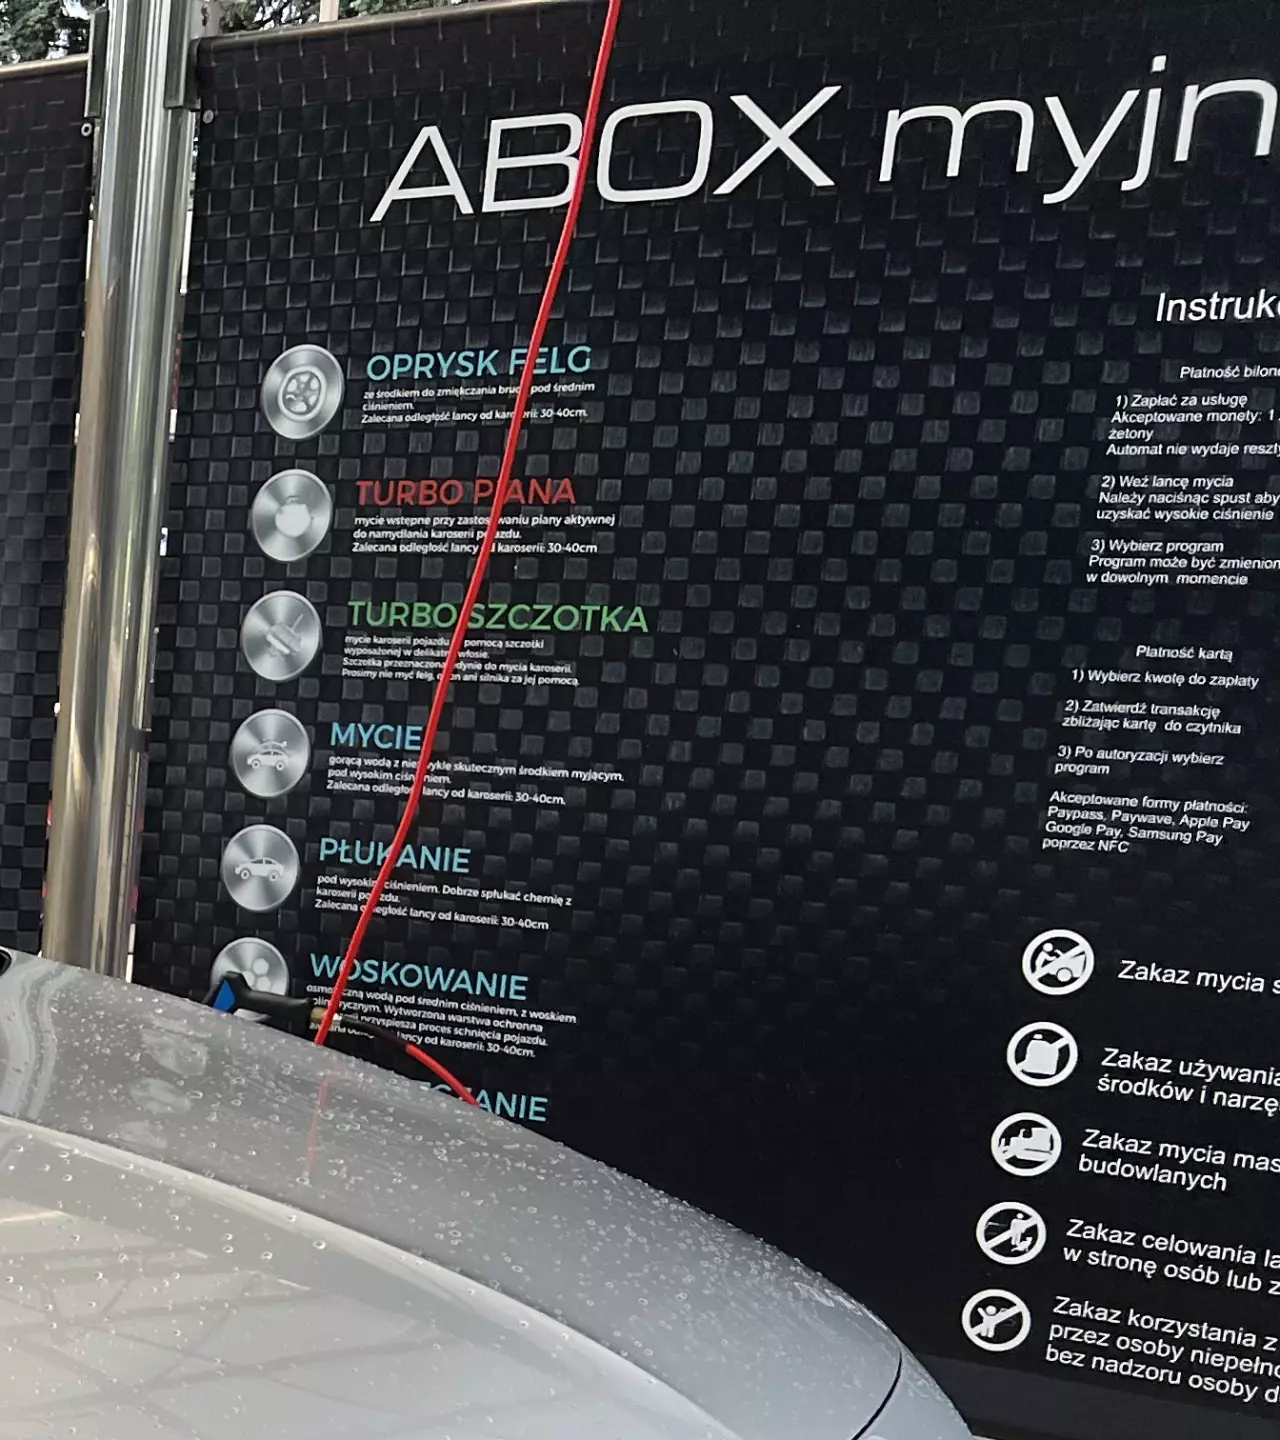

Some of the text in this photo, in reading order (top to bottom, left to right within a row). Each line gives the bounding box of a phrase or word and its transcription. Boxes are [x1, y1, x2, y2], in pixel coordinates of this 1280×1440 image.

[368, 86, 842, 222] ABOX
[1156, 288, 1280, 321] Instruk
[366, 349, 499, 380] OPRYSK
[1180, 365, 1280, 378] Płatność bilon
[422, 388, 435, 397] do
[530, 385, 550, 395] pod
[1116, 394, 1248, 409] 1) Zapłać za usługę
[452, 411, 493, 422] lancy od
[1111, 411, 1202, 425] Akceptowane
[1108, 428, 1153, 441] żetony
[1106, 444, 1162, 455] Automat
[1166, 444, 1187, 454] nie
[1191, 443, 1239, 457] wydaje
[1101, 476, 1116, 491] 2)
[1152, 475, 1189, 489] lancę
[1193, 475, 1234, 489] mycia
[356, 478, 576, 506] TURBO PANA
[1099, 492, 1145, 506] Należy
[1213, 492, 1250, 505] spust
[354, 513, 615, 528] mycie przy piany aktywnej
[1096, 508, 1274, 522] uzyskać wysokie ciśnienie
[353, 528, 367, 538] do
[451, 542, 478, 555] lancy
[1091, 539, 1224, 554] 3) Wybierz program
[1089, 555, 1145, 569] Program
[1150, 557, 1187, 568] może
[1191, 557, 1216, 570] być
[1086, 572, 1248, 586] w dowolnym momencie
[348, 601, 649, 633] TURBO SZCZOTKA
[1136, 645, 1233, 663] Płatność kartą
[1071, 669, 1259, 689] 1) Wybierz kwotę do zapłaty
[1064, 700, 1079, 713] 2)
[1151, 704, 1221, 719] transakcję
[331, 721, 423, 750] MYCIE
[1123, 720, 1156, 732] kartę
[1165, 721, 1181, 732] do
[1186, 722, 1241, 735] czytnika
[1057, 745, 1224, 765] 3) Po autoryzacji wybierz
[328, 768, 348, 778] pod
[453, 762, 516, 776] skutecznym
[519, 765, 569, 777] środkiem
[1055, 762, 1110, 775] program
[423, 785, 465, 799] lancy od
[1050, 791, 1138, 807] Akceptowane
[1142, 796, 1179, 811] formy
[1179, 815, 1218, 828] Apple
[1223, 817, 1250, 832] Pay
[1045, 822, 1092, 836] Google
[1128, 827, 1192, 843] Samsung
[1196, 830, 1223, 846] Pay
[1042, 839, 1130, 853] poprzez NFC
[318, 875, 571, 906] pod Dobrze spłukać chemię z
[409, 908, 451, 921] lancy od
[310, 953, 528, 1000] WOSKOWANIE
[1118, 959, 1189, 985] Zakaz
[1197, 971, 1265, 993] mycia
[366, 991, 393, 1003] wodą
[396, 994, 415, 1005] pod
[417, 996, 458, 1009] średnim
[529, 1011, 576, 1024] woskiem
[419, 1023, 451, 1034] proces
[448, 1013, 543, 1032] warstwa ochronna
[425, 1036, 437, 1045] od
[1101, 1047, 1172, 1073] Zakaz
[1097, 1074, 1280, 1117] środków i narzę
[1082, 1128, 1152, 1154] Zakaz
[1159, 1142, 1226, 1165] mycia
[1078, 1154, 1227, 1191] budowlanych
[1066, 1219, 1135, 1246] Zakaz
[1142, 1234, 1256, 1266] celowania
[1063, 1247, 1081, 1261] w
[1087, 1248, 1157, 1278] stronę
[1164, 1262, 1219, 1285] osób
[1227, 1270, 1262, 1291] lub
[1053, 1296, 1276, 1351] Zakaz korzystania z
[1049, 1323, 1109, 1347] przez
[1116, 1332, 1184, 1363] osoby
[1045, 1345, 1280, 1402] bez nadzoru osoby d
